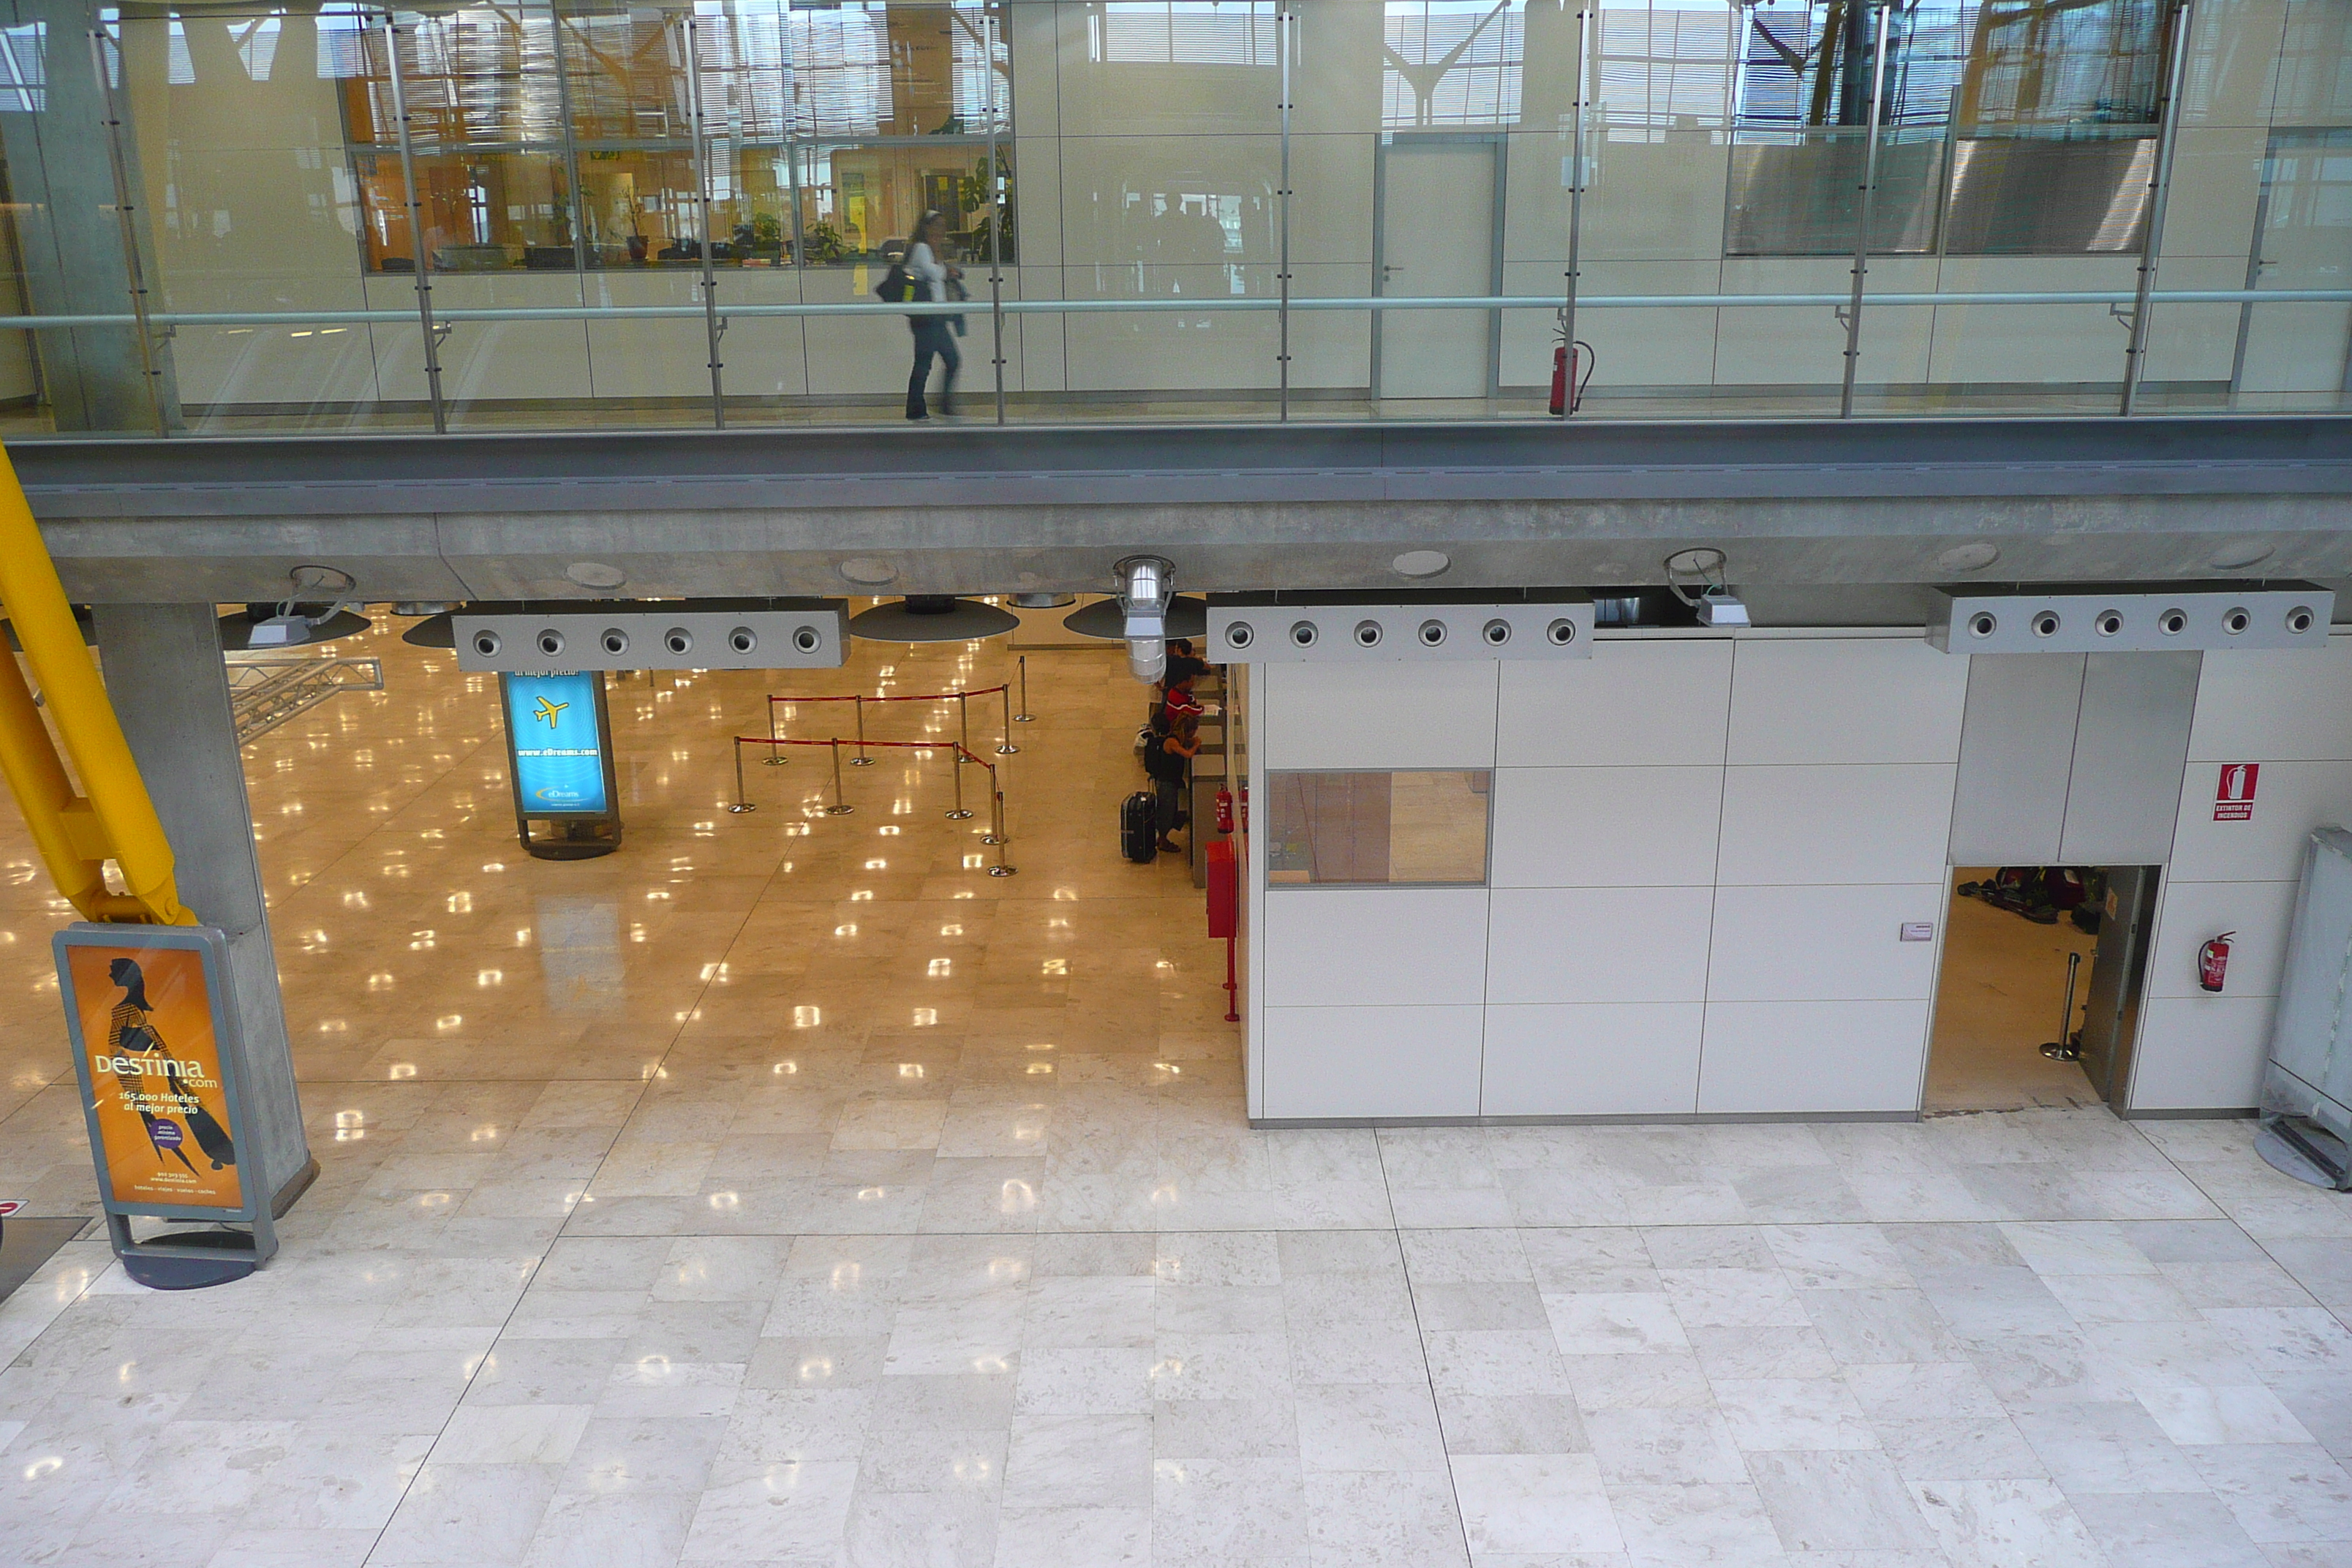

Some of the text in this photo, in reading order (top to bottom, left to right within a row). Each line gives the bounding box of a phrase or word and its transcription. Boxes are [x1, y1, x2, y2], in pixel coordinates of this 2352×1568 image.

[518, 747, 598, 756] www.eDreams.com
[548, 790, 579, 798] eDreams
[118, 1091, 200, 1104] 165.000 Hoteles
[124, 1102, 198, 1115] al mejor precio
